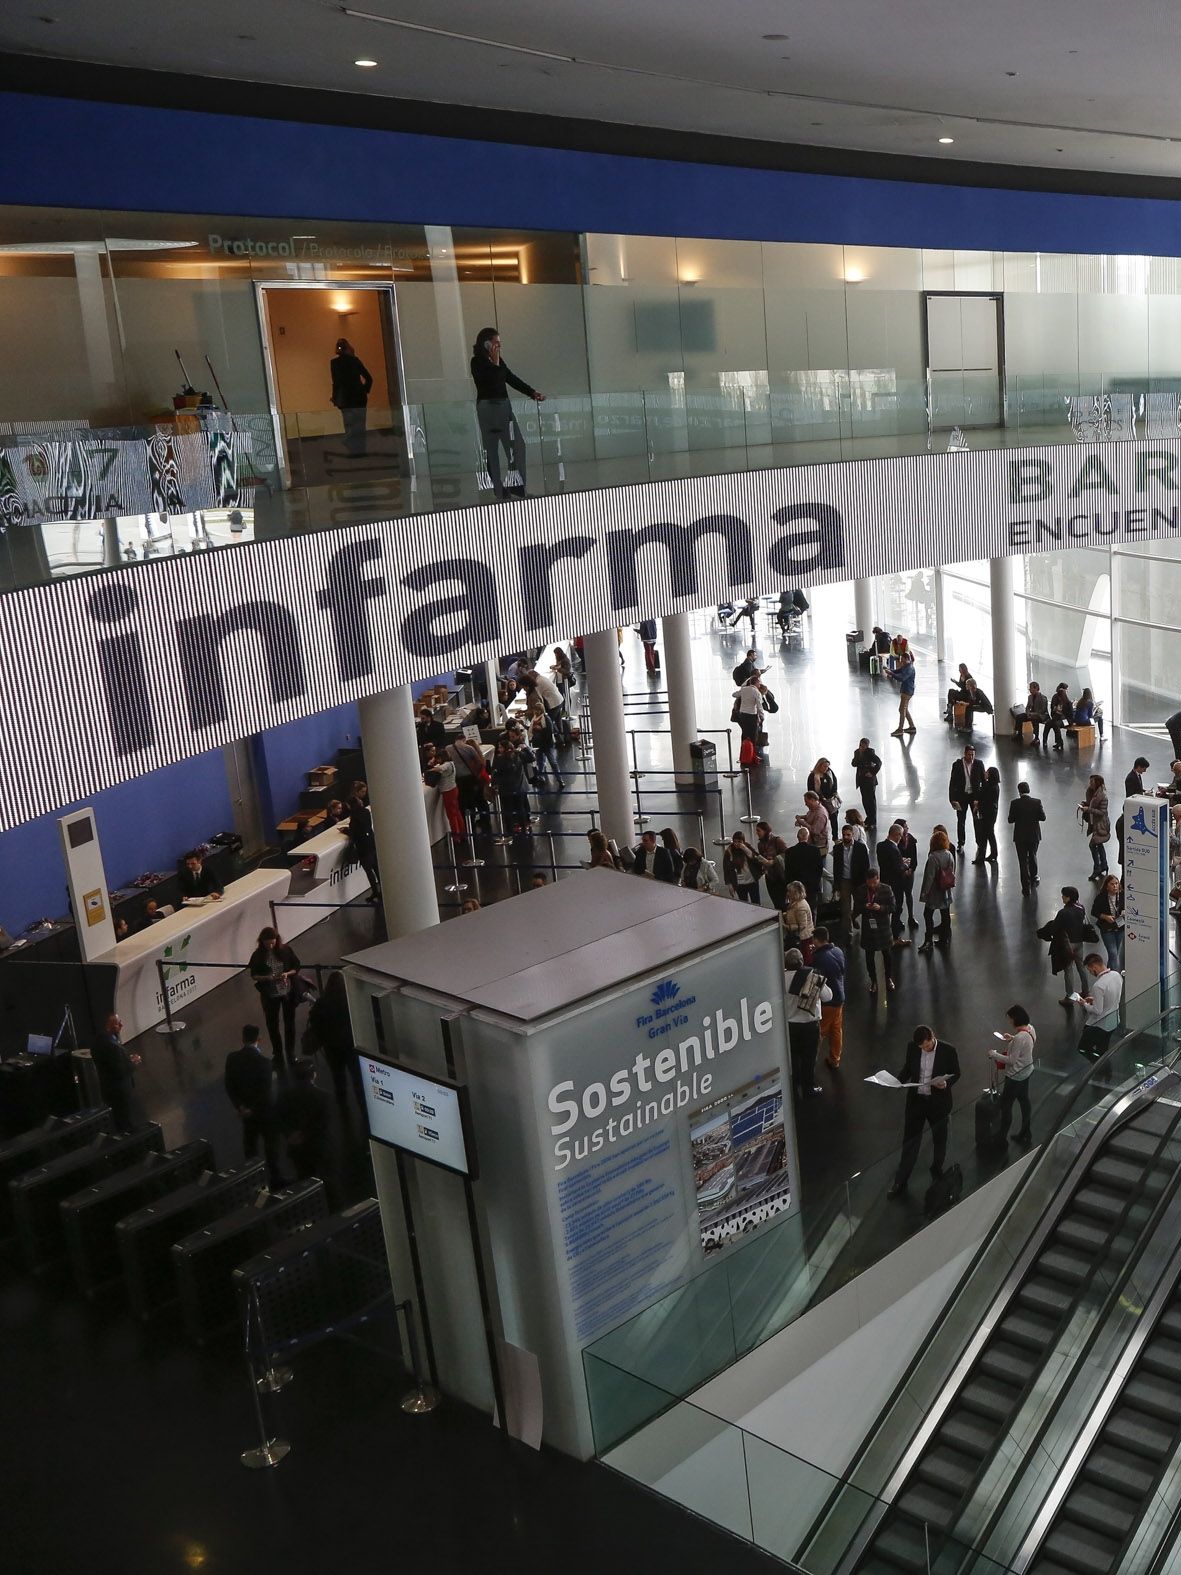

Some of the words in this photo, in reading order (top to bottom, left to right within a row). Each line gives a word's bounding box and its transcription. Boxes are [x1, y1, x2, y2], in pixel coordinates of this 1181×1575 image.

[208, 233, 295, 257] Protocol
[87, 500, 847, 758] infarma
[636, 1014, 654, 1029] Fira
[655, 995, 697, 1019] Barcelona
[648, 1022, 672, 1039] Gran
[673, 1015, 689, 1029] Via
[547, 997, 774, 1136] Sostenible
[554, 1072, 713, 1171] Sustainable
